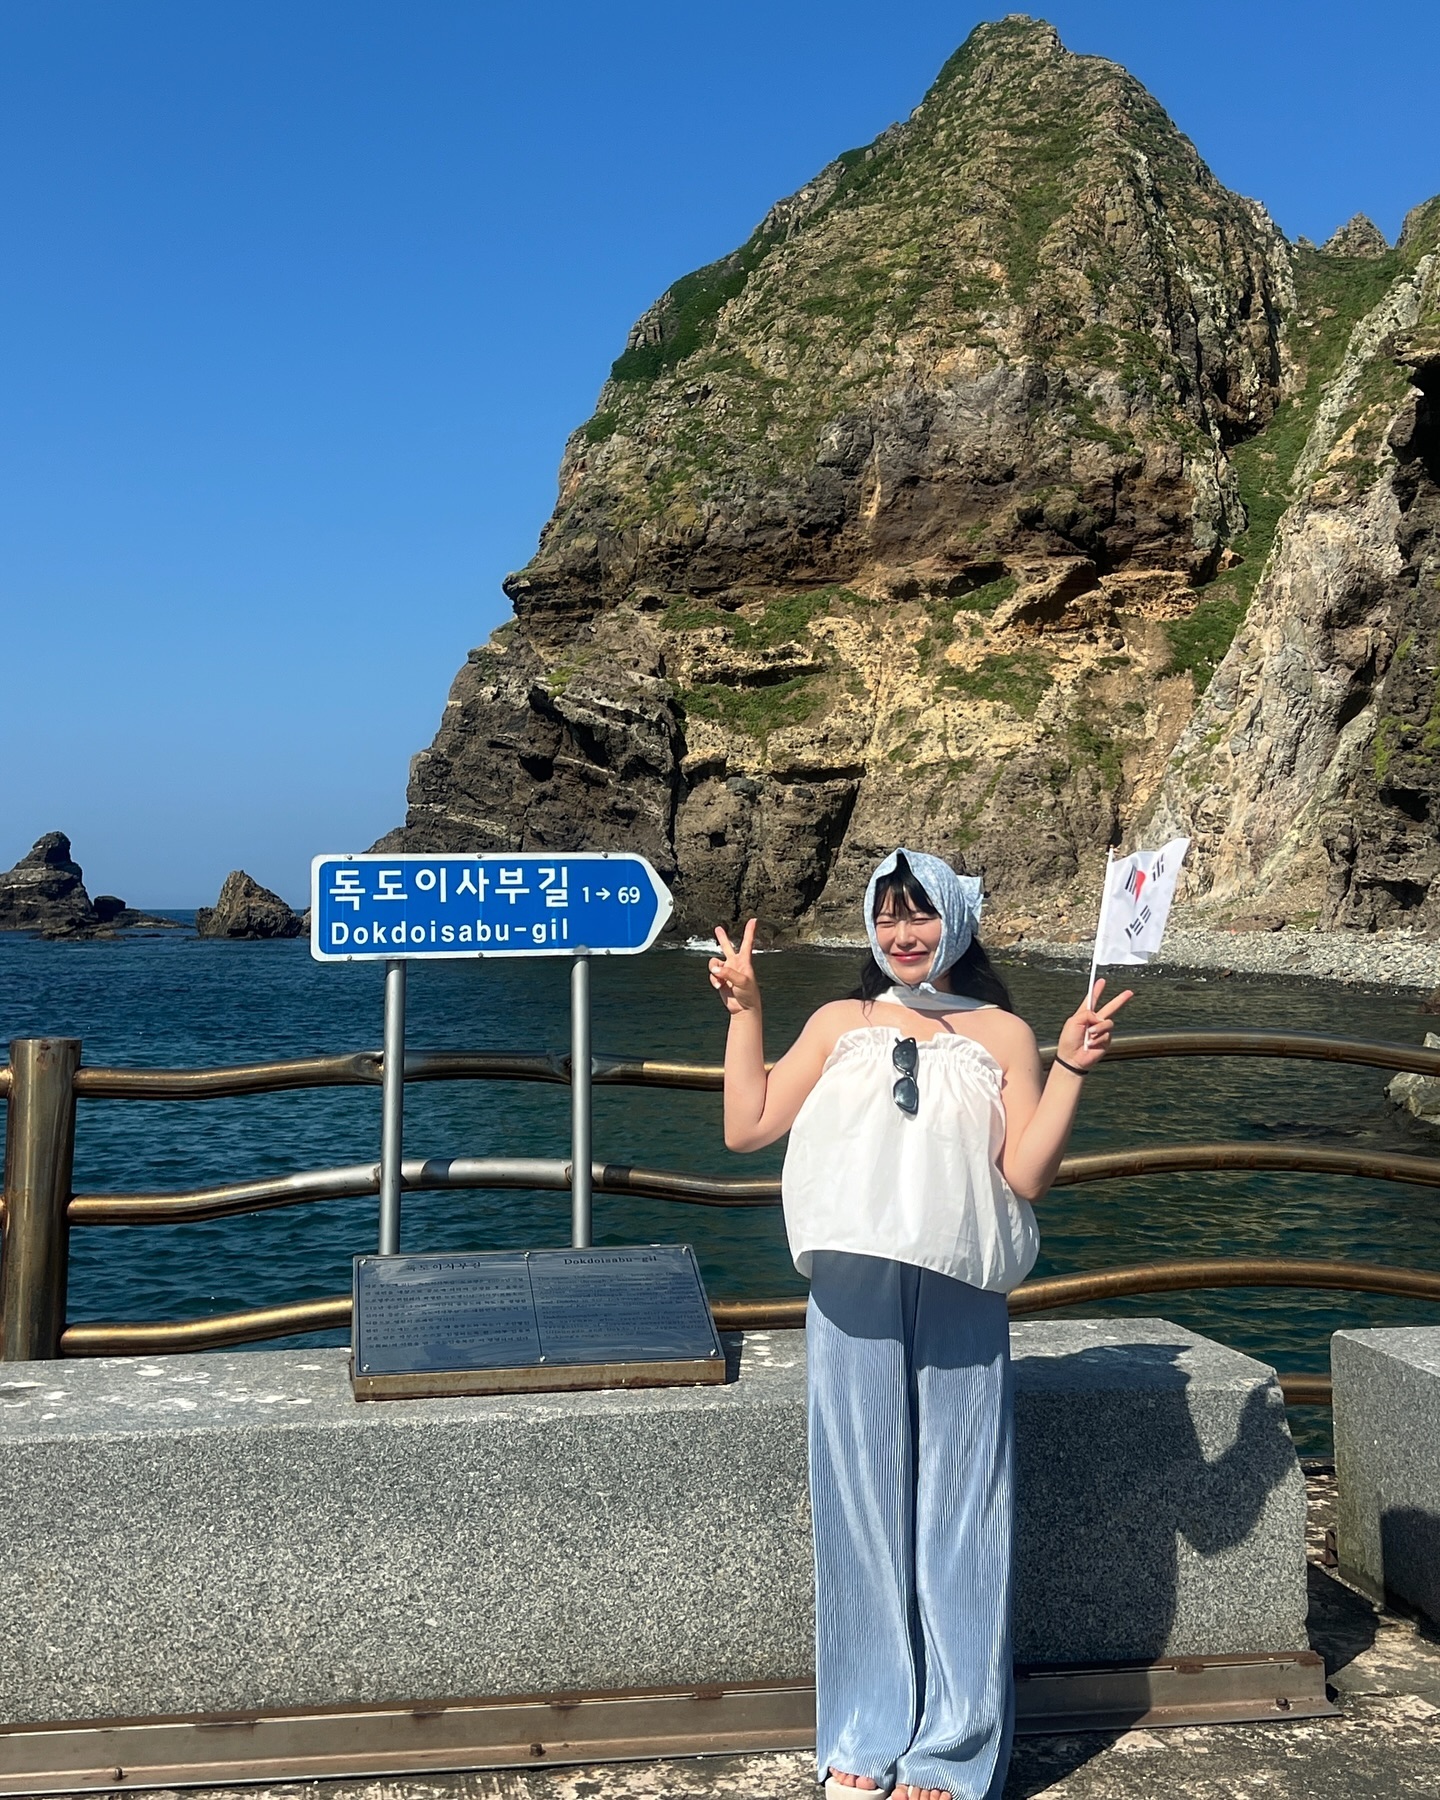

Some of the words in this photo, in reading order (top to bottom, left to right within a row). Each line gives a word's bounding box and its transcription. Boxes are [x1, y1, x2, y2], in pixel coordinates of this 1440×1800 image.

[329, 866, 569, 911] 독도이사부길
[581, 886, 590, 903] 1
[617, 886, 641, 904] 69
[331, 918, 569, 945] Dokdoisabu-gil
